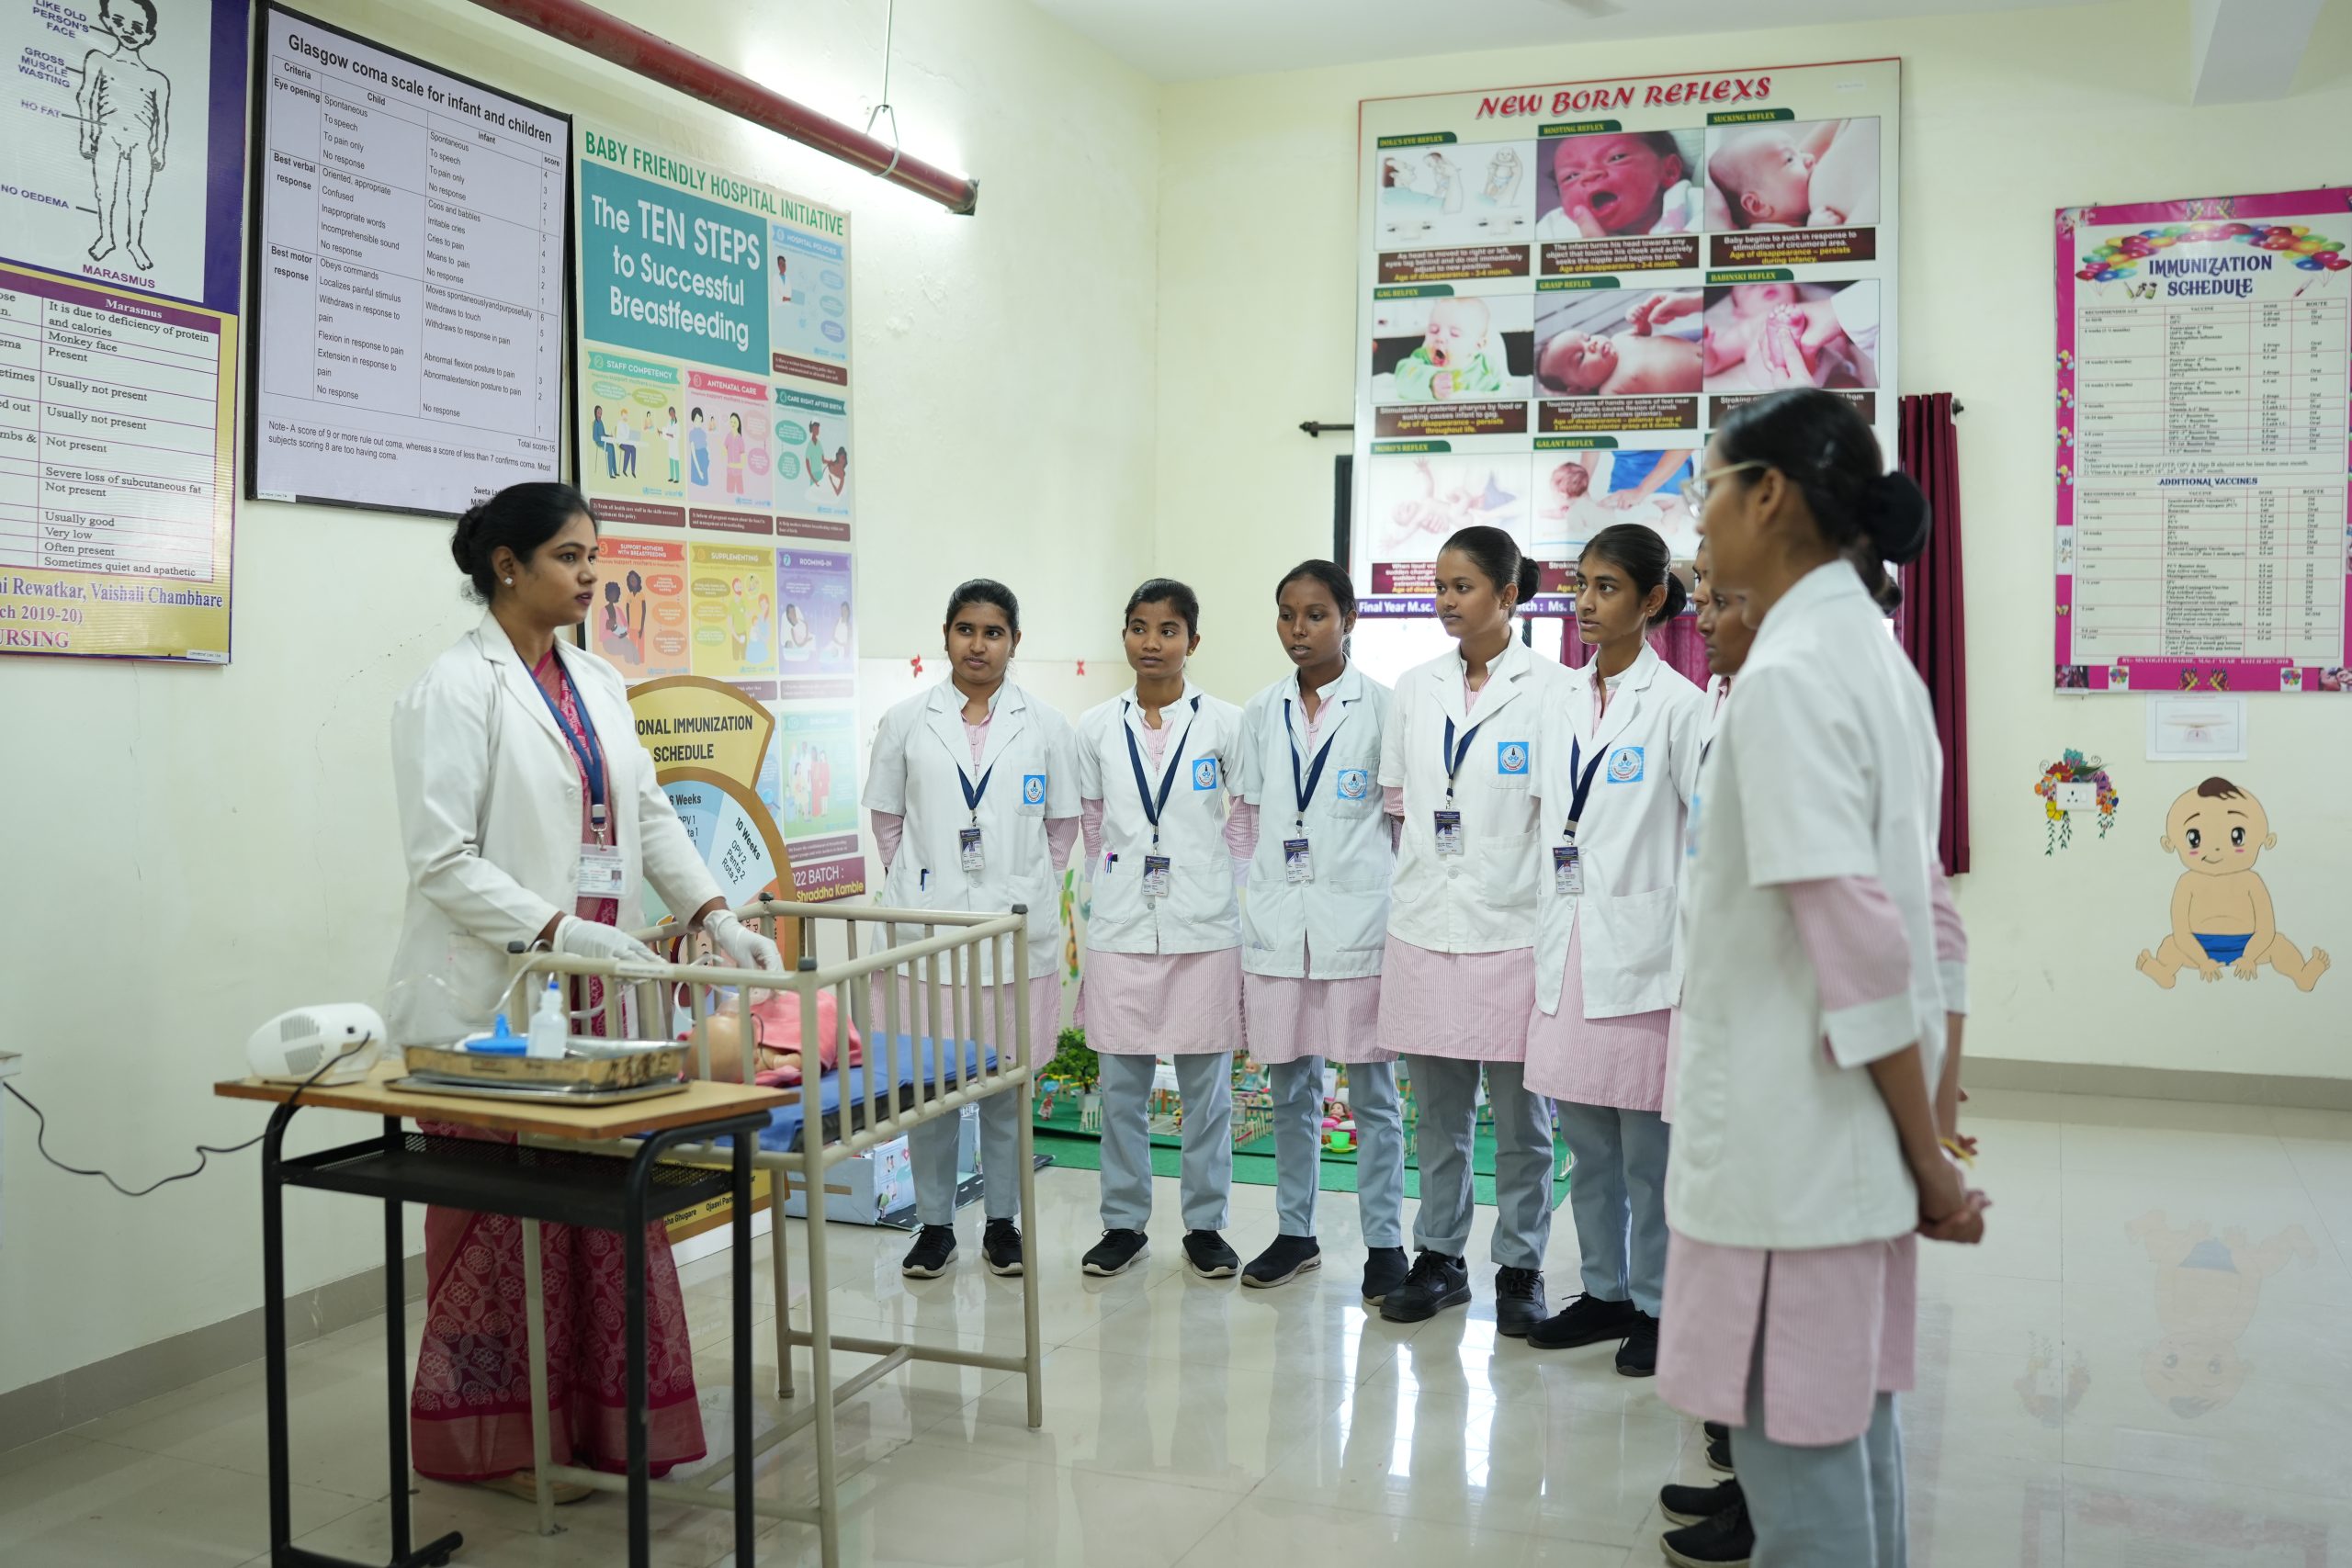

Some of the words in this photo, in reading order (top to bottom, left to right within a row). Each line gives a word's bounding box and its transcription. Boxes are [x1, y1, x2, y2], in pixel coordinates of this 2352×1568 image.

[33, 7, 89, 32] PERSON'S
[35, 0, 61, 13] LIKE
[64, 8, 86, 21] OLD
[47, 22, 75, 38] FACE
[21, 56, 68, 77] MUSCLE
[25, 47, 64, 66] GROSS
[18, 65, 70, 87] WASTING
[274, 78, 291, 93] Eye
[290, 85, 321, 104] opening
[288, 34, 348, 69] Glasgow
[352, 62, 388, 85] coma
[391, 74, 424, 96] scale
[427, 86, 444, 104] for
[447, 96, 481, 118] infant
[484, 108, 505, 126] and
[508, 118, 552, 144] children
[1475, 94, 1543, 118] NEW
[1552, 86, 1634, 116] BORN
[1645, 77, 1772, 107] REFLEXS
[284, 62, 311, 80] Criteria
[367, 93, 386, 106] Child
[478, 130, 495, 145] Infant
[544, 156, 560, 167] score
[324, 96, 368, 118] Spontaneous
[1713, 113, 1747, 123] SUCKING
[1748, 111, 1775, 121] REFLEX
[430, 131, 469, 152] Spontaneous
[274, 153, 291, 167] Best
[293, 159, 316, 174] verbal
[277, 174, 311, 190] response
[322, 168, 353, 185] Oriented,
[355, 176, 391, 196] appropriate
[586, 131, 628, 165] BABY
[634, 148, 706, 191] FRIENDLY
[711, 175, 777, 215] HOSPITAL
[781, 197, 843, 236] INITIATIVE
[1, 185, 17, 195] NO
[21, 190, 69, 209] OEDEMA
[322, 186, 354, 202] Confused
[322, 205, 365, 223] Inappropriate
[366, 217, 386, 229] words
[428, 200, 444, 212] Coos
[446, 206, 458, 216] and
[458, 209, 481, 222] babbles
[427, 217, 450, 230] Irritable
[451, 223, 466, 234] cries
[592, 194, 630, 233] The
[638, 198, 685, 250] TEN
[695, 218, 761, 270] STEPS
[322, 223, 379, 244] Incomprehensible
[379, 237, 400, 250] sound
[271, 246, 288, 259] Best
[290, 251, 312, 264] motor
[2148, 254, 2272, 277] IMMUNIZATION
[83, 265, 154, 288] MARASMUS
[274, 266, 309, 281] response
[320, 258, 342, 273] Obeys
[343, 265, 379, 280] commands
[614, 245, 634, 277] to
[641, 253, 744, 307] Successful
[320, 276, 351, 292] Localizes
[352, 283, 374, 298] painful
[376, 288, 401, 302] stimulus
[1539, 280, 1563, 289] GRASP
[1565, 279, 1590, 288] REFLEX
[2167, 278, 2253, 298] SCHEDULE
[105, 299, 162, 318] Marasmus
[610, 285, 748, 352] Breastfeeding
[49, 302, 59, 311] It
[62, 303, 70, 313] is
[74, 306, 92, 319] due
[96, 310, 106, 321] to
[108, 313, 160, 333] deficiency
[164, 326, 175, 334] of
[175, 331, 209, 343] protein
[49, 318, 69, 328] and
[72, 321, 112, 336] calories
[49, 332, 93, 348] Monkey
[96, 342, 118, 352] face
[318, 331, 342, 344] Flexion
[344, 335, 350, 344] in
[351, 338, 381, 353] response
[383, 344, 390, 353] to
[390, 344, 404, 355] pain
[48, 347, 87, 362] Present
[607, 360, 628, 370] STAFF
[628, 365, 672, 379] COMPETENCY
[48, 377, 88, 392] Usually
[92, 385, 108, 394] not
[111, 389, 147, 401] present
[707, 380, 741, 392] ANTENATAL
[741, 387, 756, 395] CARE
[800, 397, 814, 406] RIGHT
[815, 400, 829, 409] AFTER
[829, 402, 842, 411] BIRTH
[46, 437, 66, 447] Not
[69, 441, 107, 452] present
[517, 439, 530, 448] Total
[1566, 438, 1594, 447] REFLEX
[46, 468, 82, 479] Severe
[85, 472, 105, 482] loss
[121, 477, 186, 491] subcutaneous
[189, 485, 201, 494] fat
[2157, 478, 2213, 488] ADDITIONAL
[2215, 477, 2257, 485] VACCINES
[45, 512, 85, 525] Usually
[89, 517, 115, 526] good
[45, 527, 70, 539] Very
[74, 530, 92, 539] low
[45, 542, 74, 552] Often
[78, 547, 115, 556] present
[711, 552, 759, 562] SUPPLEMENTING
[45, 558, 102, 570] Sometimes
[106, 563, 130, 572] quiet
[153, 567, 196, 577] apathetic
[799, 558, 832, 567] ROOMING-IN
[13, 578, 87, 602] Rewatkar,
[148, 587, 222, 607] Chambhare
[21, 606, 83, 625] 2019-20)
[1359, 601, 1383, 613] Final
[1385, 601, 1406, 613] Year
[1408, 601, 1434, 613] M.sc.
[673, 716, 752, 733] IMMUNIZATION
[654, 744, 714, 762] SCHEDULE
[676, 794, 701, 806] Weeks
[735, 818, 742, 830] 10
[742, 828, 761, 860] Weeks
[731, 840, 742, 858] OPV
[741, 856, 747, 864] 2
[722, 858, 735, 878] Rota
[733, 876, 739, 885] 2
[727, 848, 741, 874] Penta
[740, 871, 746, 880] 2
[808, 865, 839, 884] BATCH
[797, 886, 833, 902] Shraddha
[835, 881, 864, 896] Kamble
[675, 1209, 696, 1223] Ghugare
[707, 1198, 721, 1212] Ojasvi
